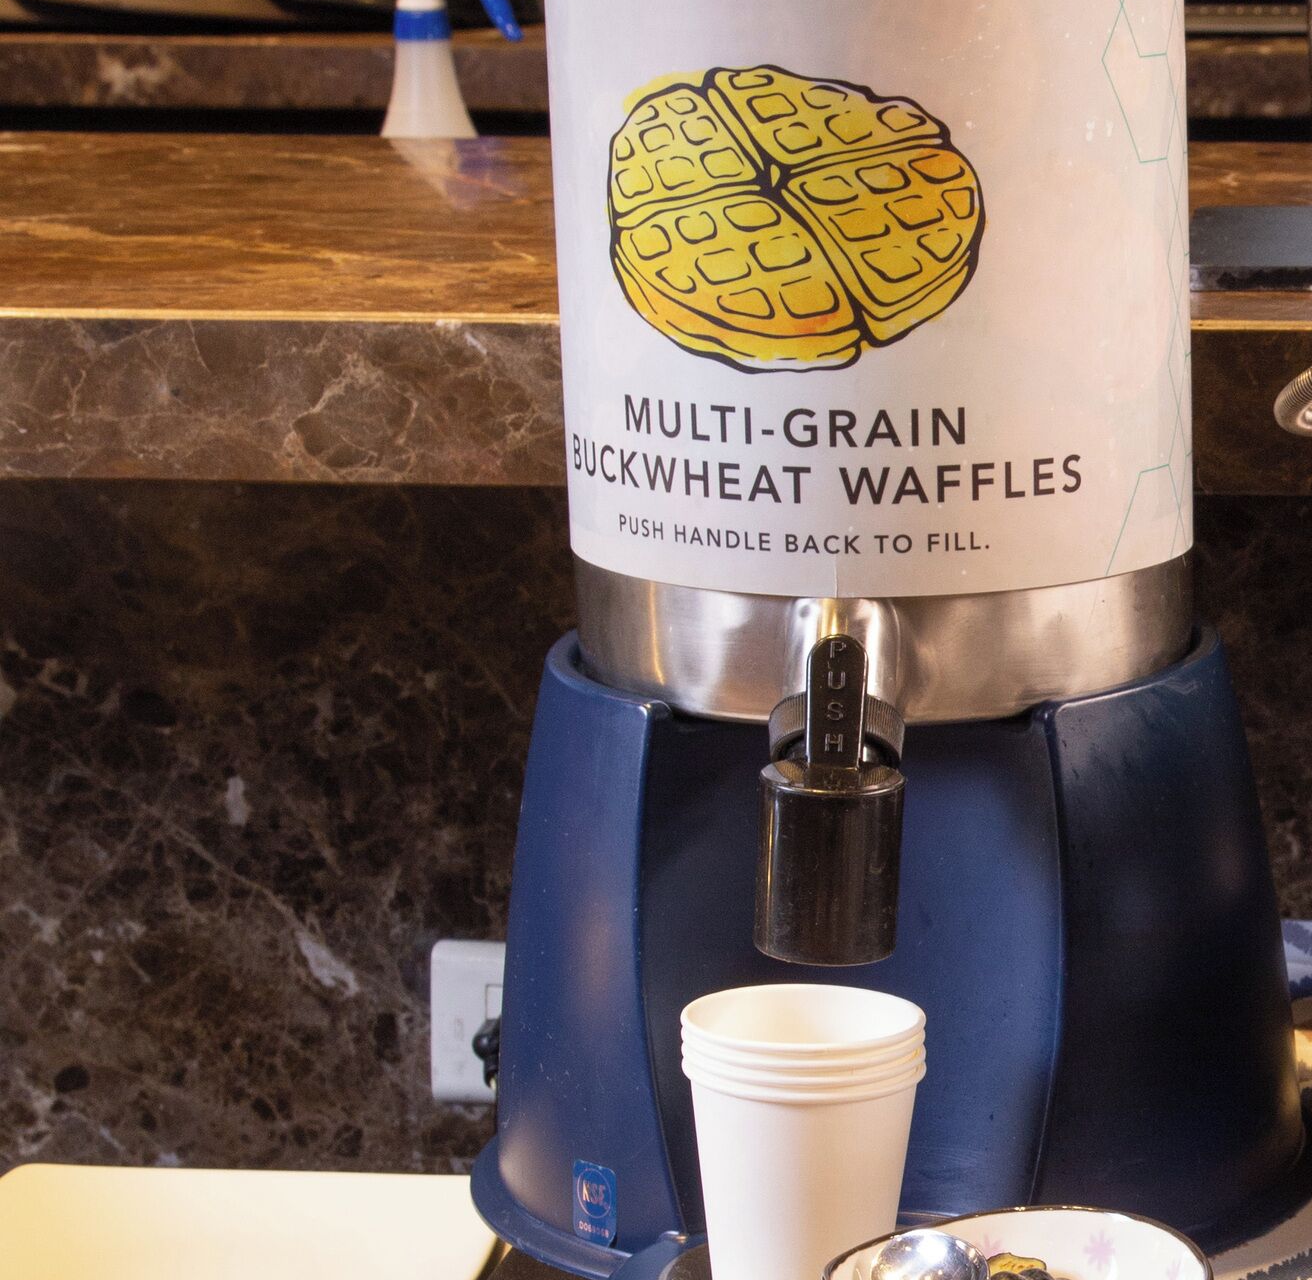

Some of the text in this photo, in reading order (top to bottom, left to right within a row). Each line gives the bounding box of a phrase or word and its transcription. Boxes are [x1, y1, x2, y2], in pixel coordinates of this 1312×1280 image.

[624, 393, 967, 448] MULTI-GRAIN
[572, 433, 1083, 506] BUCKWHEAT WAFFLES
[618, 514, 990, 555] PUSH HANDLE BACK TO FILL.
[823, 640, 848, 754] PUSH
